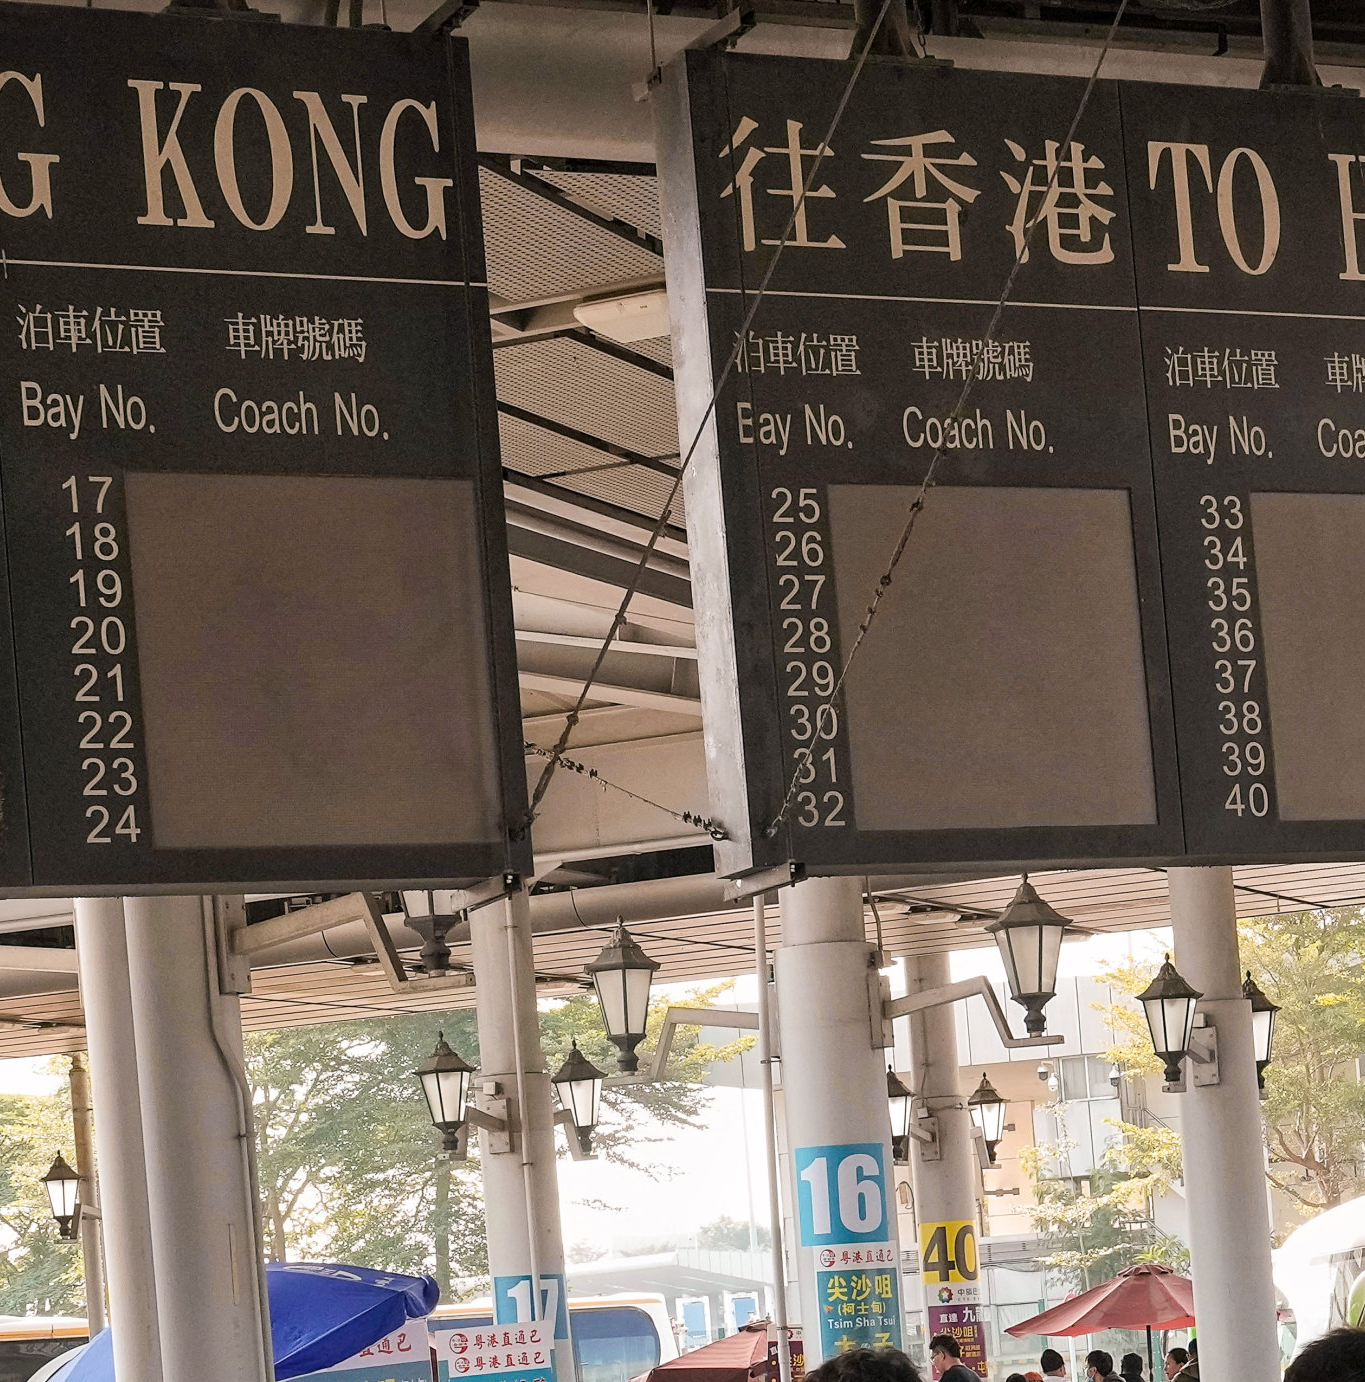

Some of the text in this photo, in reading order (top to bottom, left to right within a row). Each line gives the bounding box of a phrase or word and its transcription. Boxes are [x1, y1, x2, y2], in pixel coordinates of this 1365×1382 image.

[128, 80, 453, 240] KONG
[718, 115, 1117, 266] 往香港
[1147, 140, 1280, 276] TO
[17, 305, 165, 354] 泊車位置
[226, 313, 366, 362] 車牌號碼
[735, 331, 860, 376] 泊車位置
[912, 337, 1033, 381] 車牌號碼
[1165, 347, 1279, 389] 泊車位置
[21, 382, 154, 439] Bay No.
[215, 388, 388, 439] Coach No.
[738, 403, 852, 455] Bay No.
[904, 407, 1053, 453] Coach No.
[1169, 414, 1272, 464] Bay No.
[63, 476, 112, 513] 17
[772, 488, 819, 523] 25
[1201, 496, 1243, 529] 33
[66, 522, 118, 560] 18
[776, 531, 823, 566] 26
[1204, 537, 1246, 569] 34
[70, 570, 121, 607] 19
[779, 575, 825, 609] 27
[1208, 578, 1250, 610] 35
[71, 617, 125, 654] 20
[783, 618, 830, 652] 28
[1211, 619, 1254, 652] 36
[75, 664, 123, 701] 21
[786, 660, 835, 698] 29
[1215, 660, 1256, 693] 37
[79, 711, 133, 748] 22
[789, 703, 838, 742] 30
[1219, 701, 1261, 734] 38
[82, 758, 137, 795] 23
[793, 747, 837, 785] 31
[1223, 742, 1264, 775] 39
[798, 791, 845, 826] 32
[1226, 784, 1268, 816] 40
[86, 805, 140, 843] 24
[800, 1153, 883, 1235] 16
[922, 1224, 978, 1282] 40
[506, 1278, 559, 1323] 17
[827, 1274, 893, 1302] 尖沙咀
[827, 1315, 896, 1329] Tsim Sha Tsui
